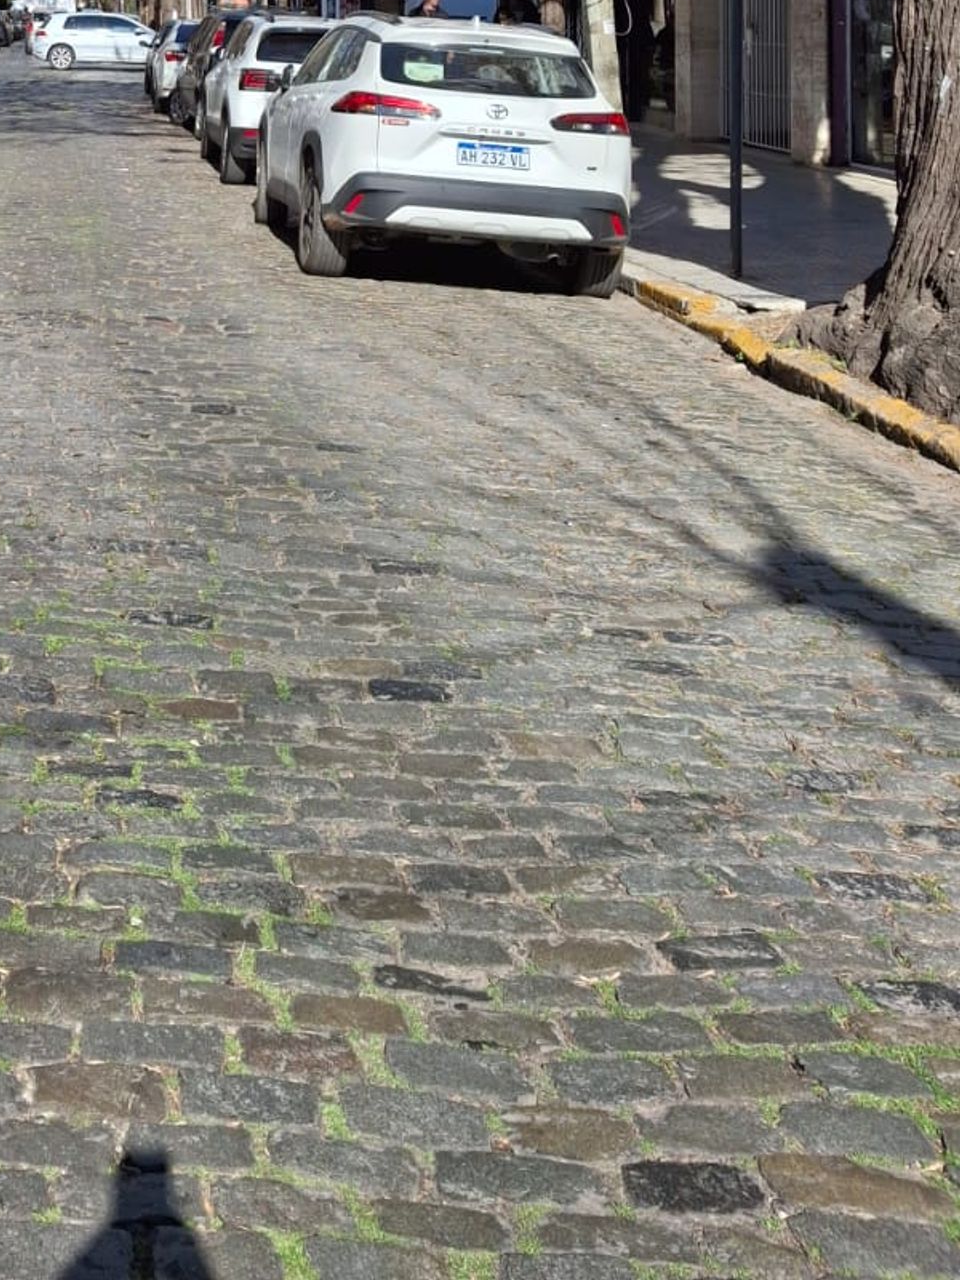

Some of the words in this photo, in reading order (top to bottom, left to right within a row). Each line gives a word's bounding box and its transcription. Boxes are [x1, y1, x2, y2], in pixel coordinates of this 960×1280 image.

[460, 149, 478, 163] AH
[481, 151, 506, 166] 232
[510, 153, 527, 168] VL
